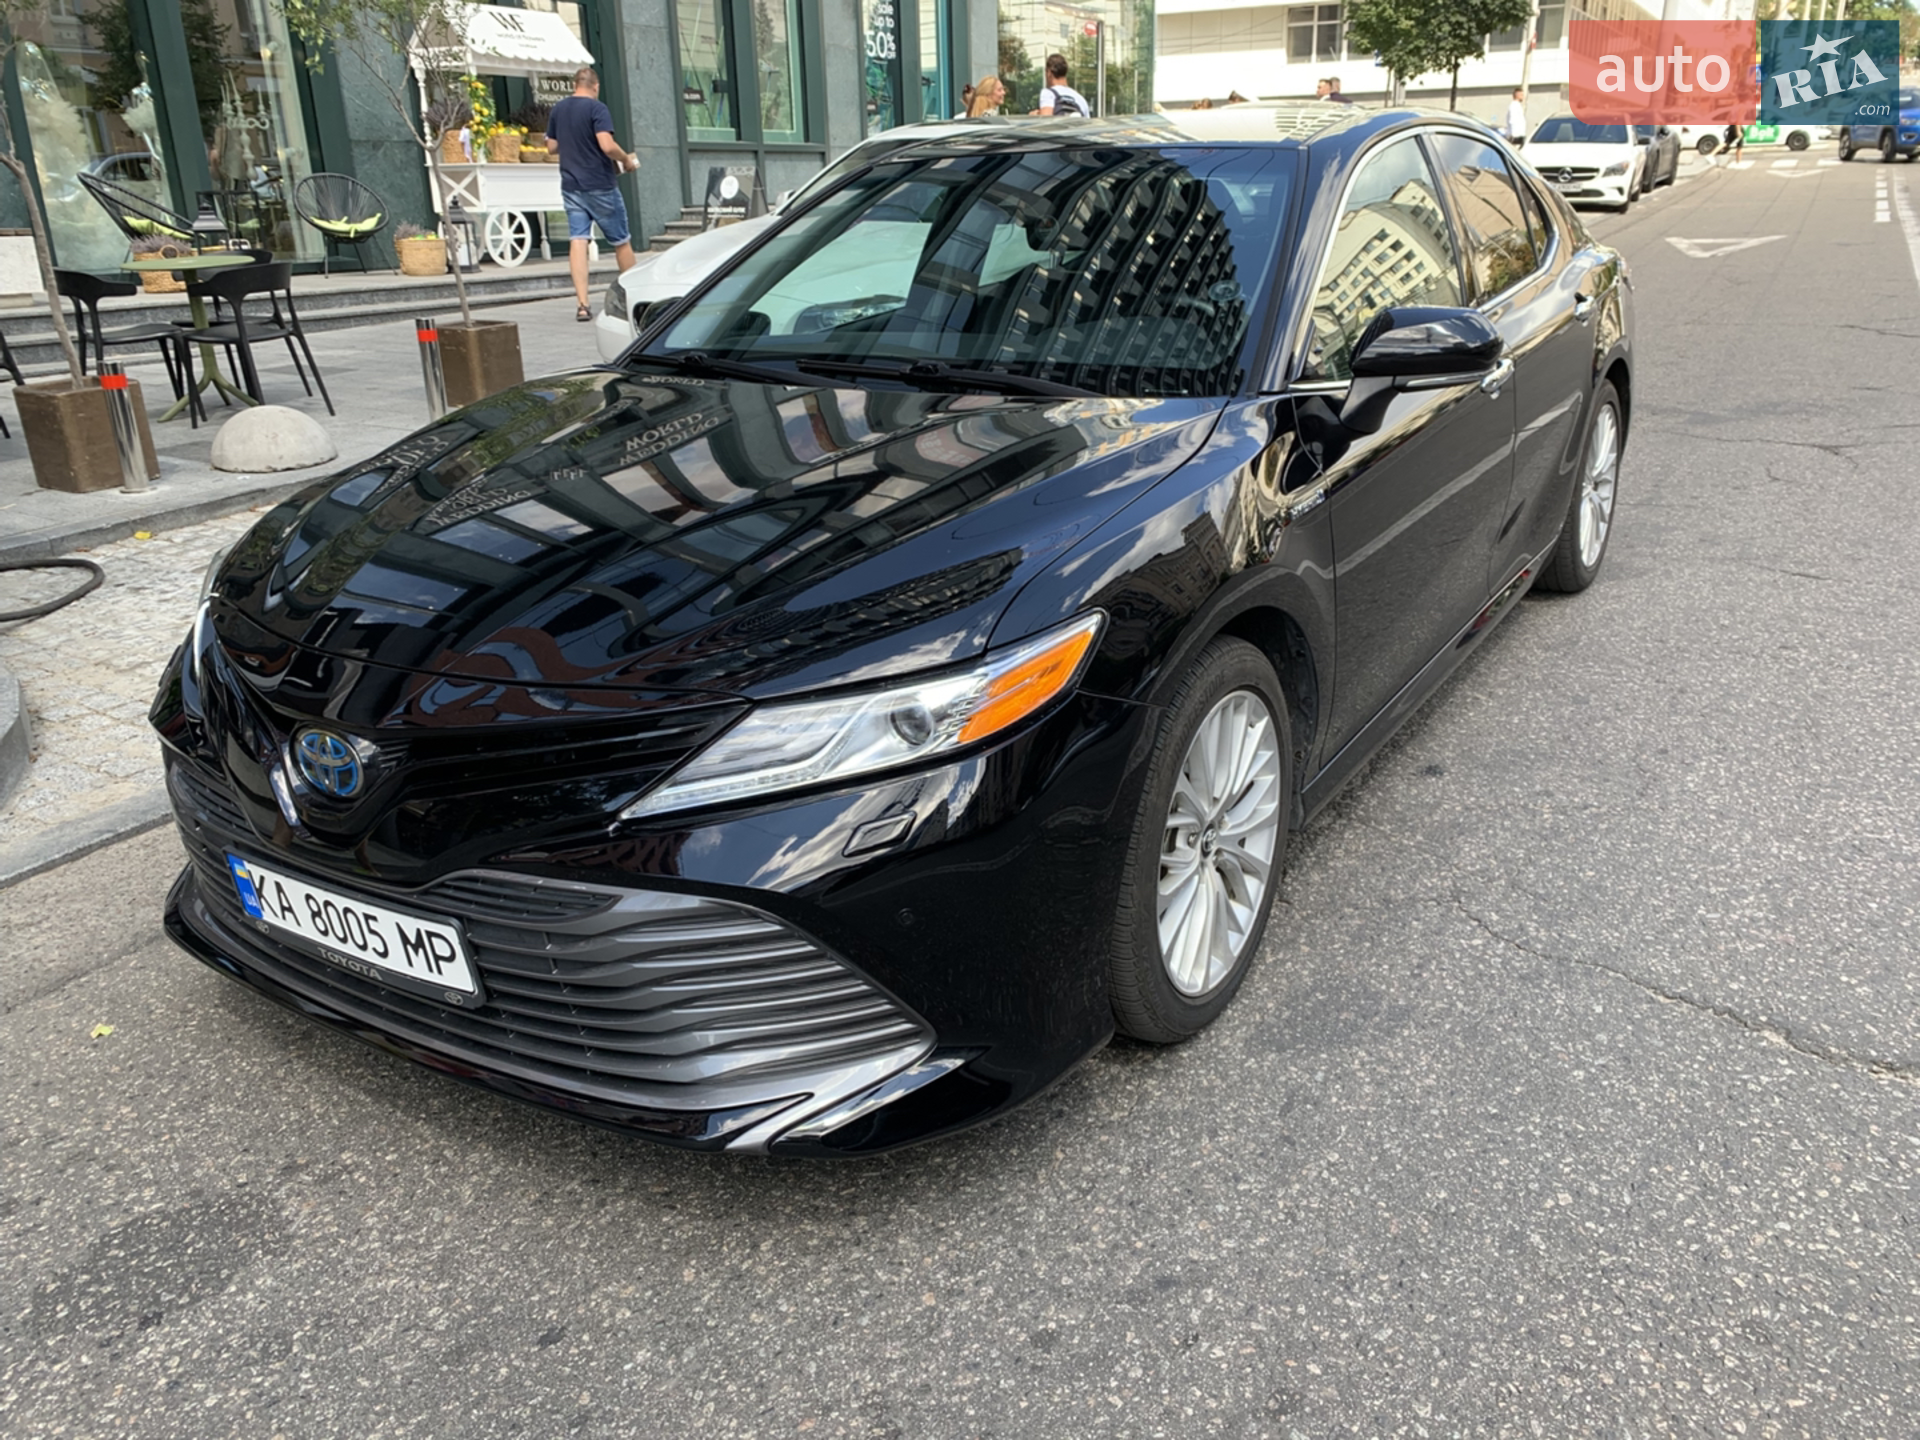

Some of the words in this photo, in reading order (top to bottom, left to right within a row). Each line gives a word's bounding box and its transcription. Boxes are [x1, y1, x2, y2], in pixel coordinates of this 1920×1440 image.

[247, 869, 302, 927] KA
[304, 893, 389, 959] 8005
[395, 921, 457, 976] MP
[317, 946, 383, 981] TOYOTA
